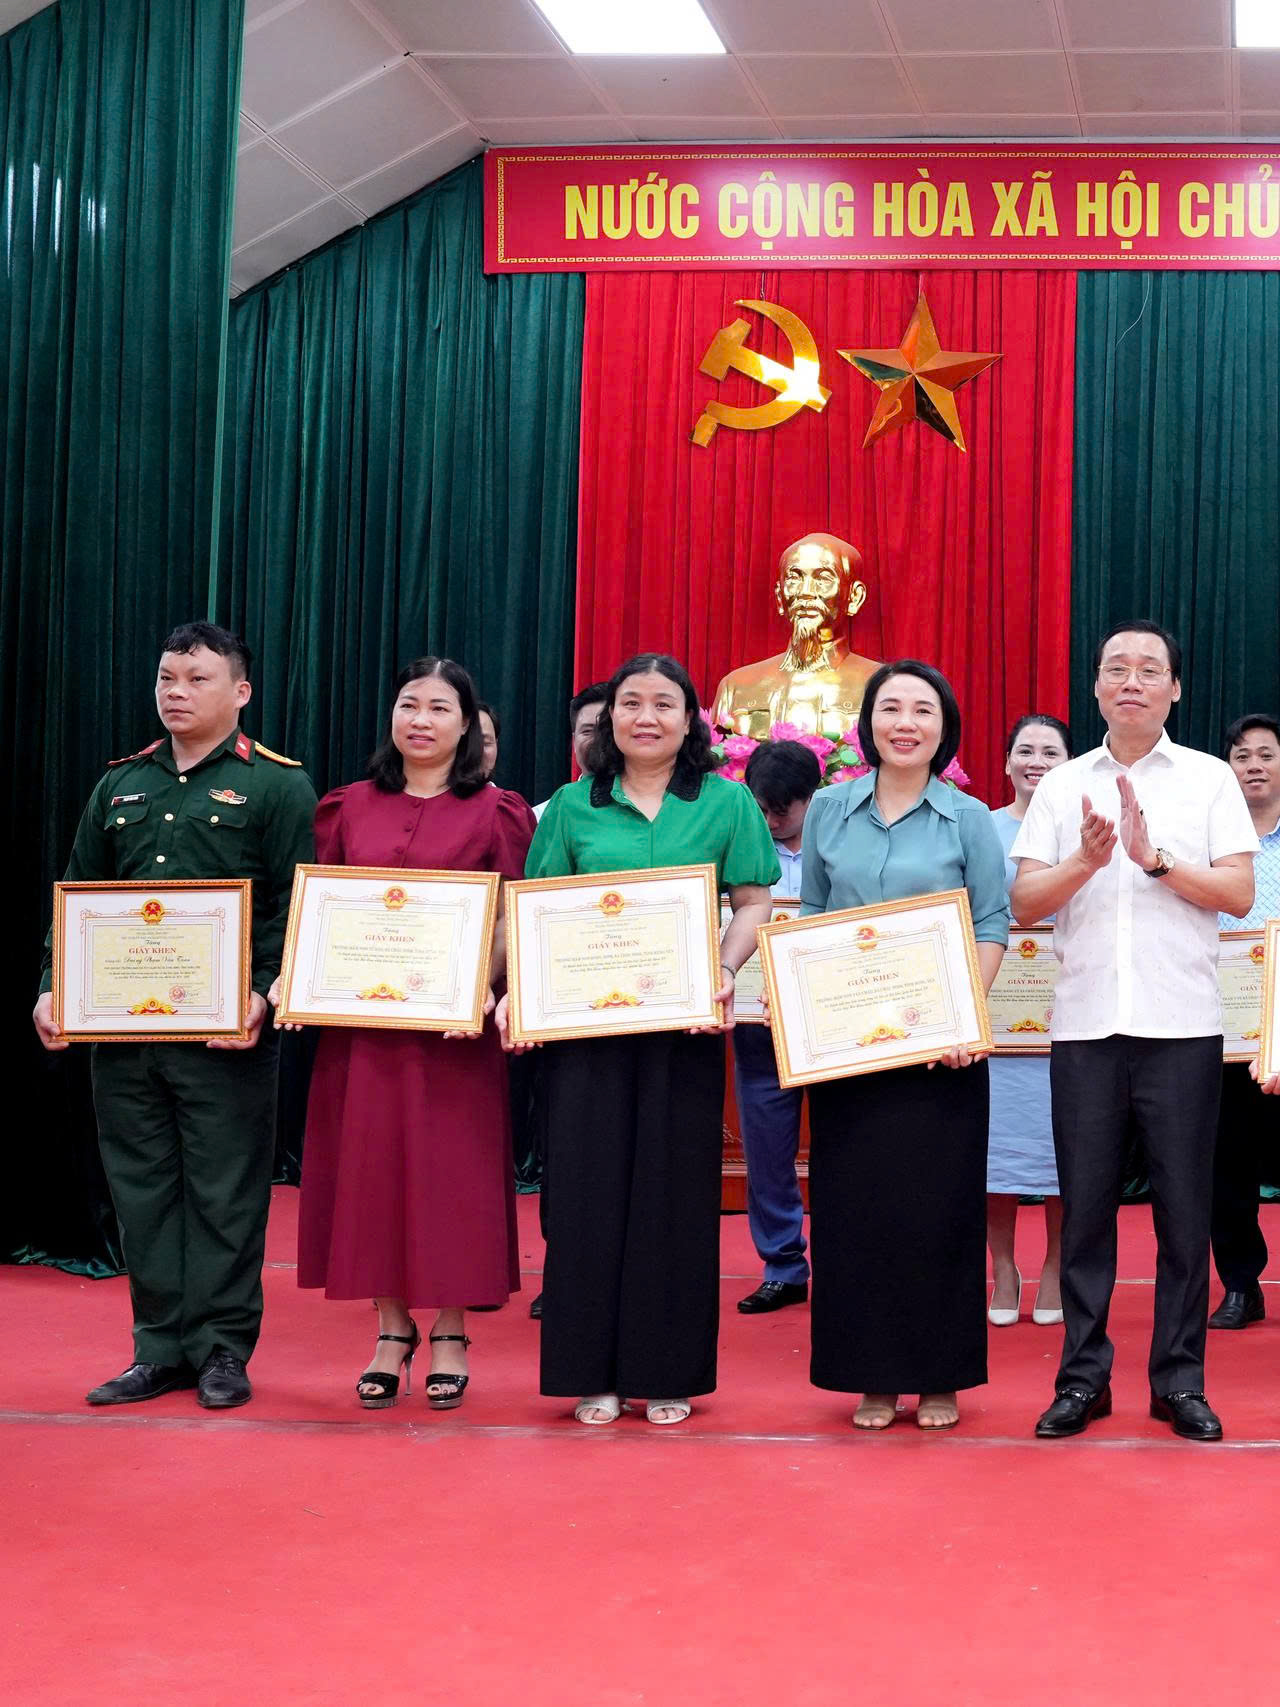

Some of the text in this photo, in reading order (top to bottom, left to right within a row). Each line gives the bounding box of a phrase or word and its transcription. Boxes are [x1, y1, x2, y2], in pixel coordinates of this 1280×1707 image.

[564, 172, 700, 240] NƯỚC
[718, 170, 856, 250] CỘNG
[872, 168, 974, 238] HÒA
[994, 170, 1059, 238] XÃ
[1076, 170, 1159, 250] HỘI
[1178, 164, 1280, 238] CHỦ
